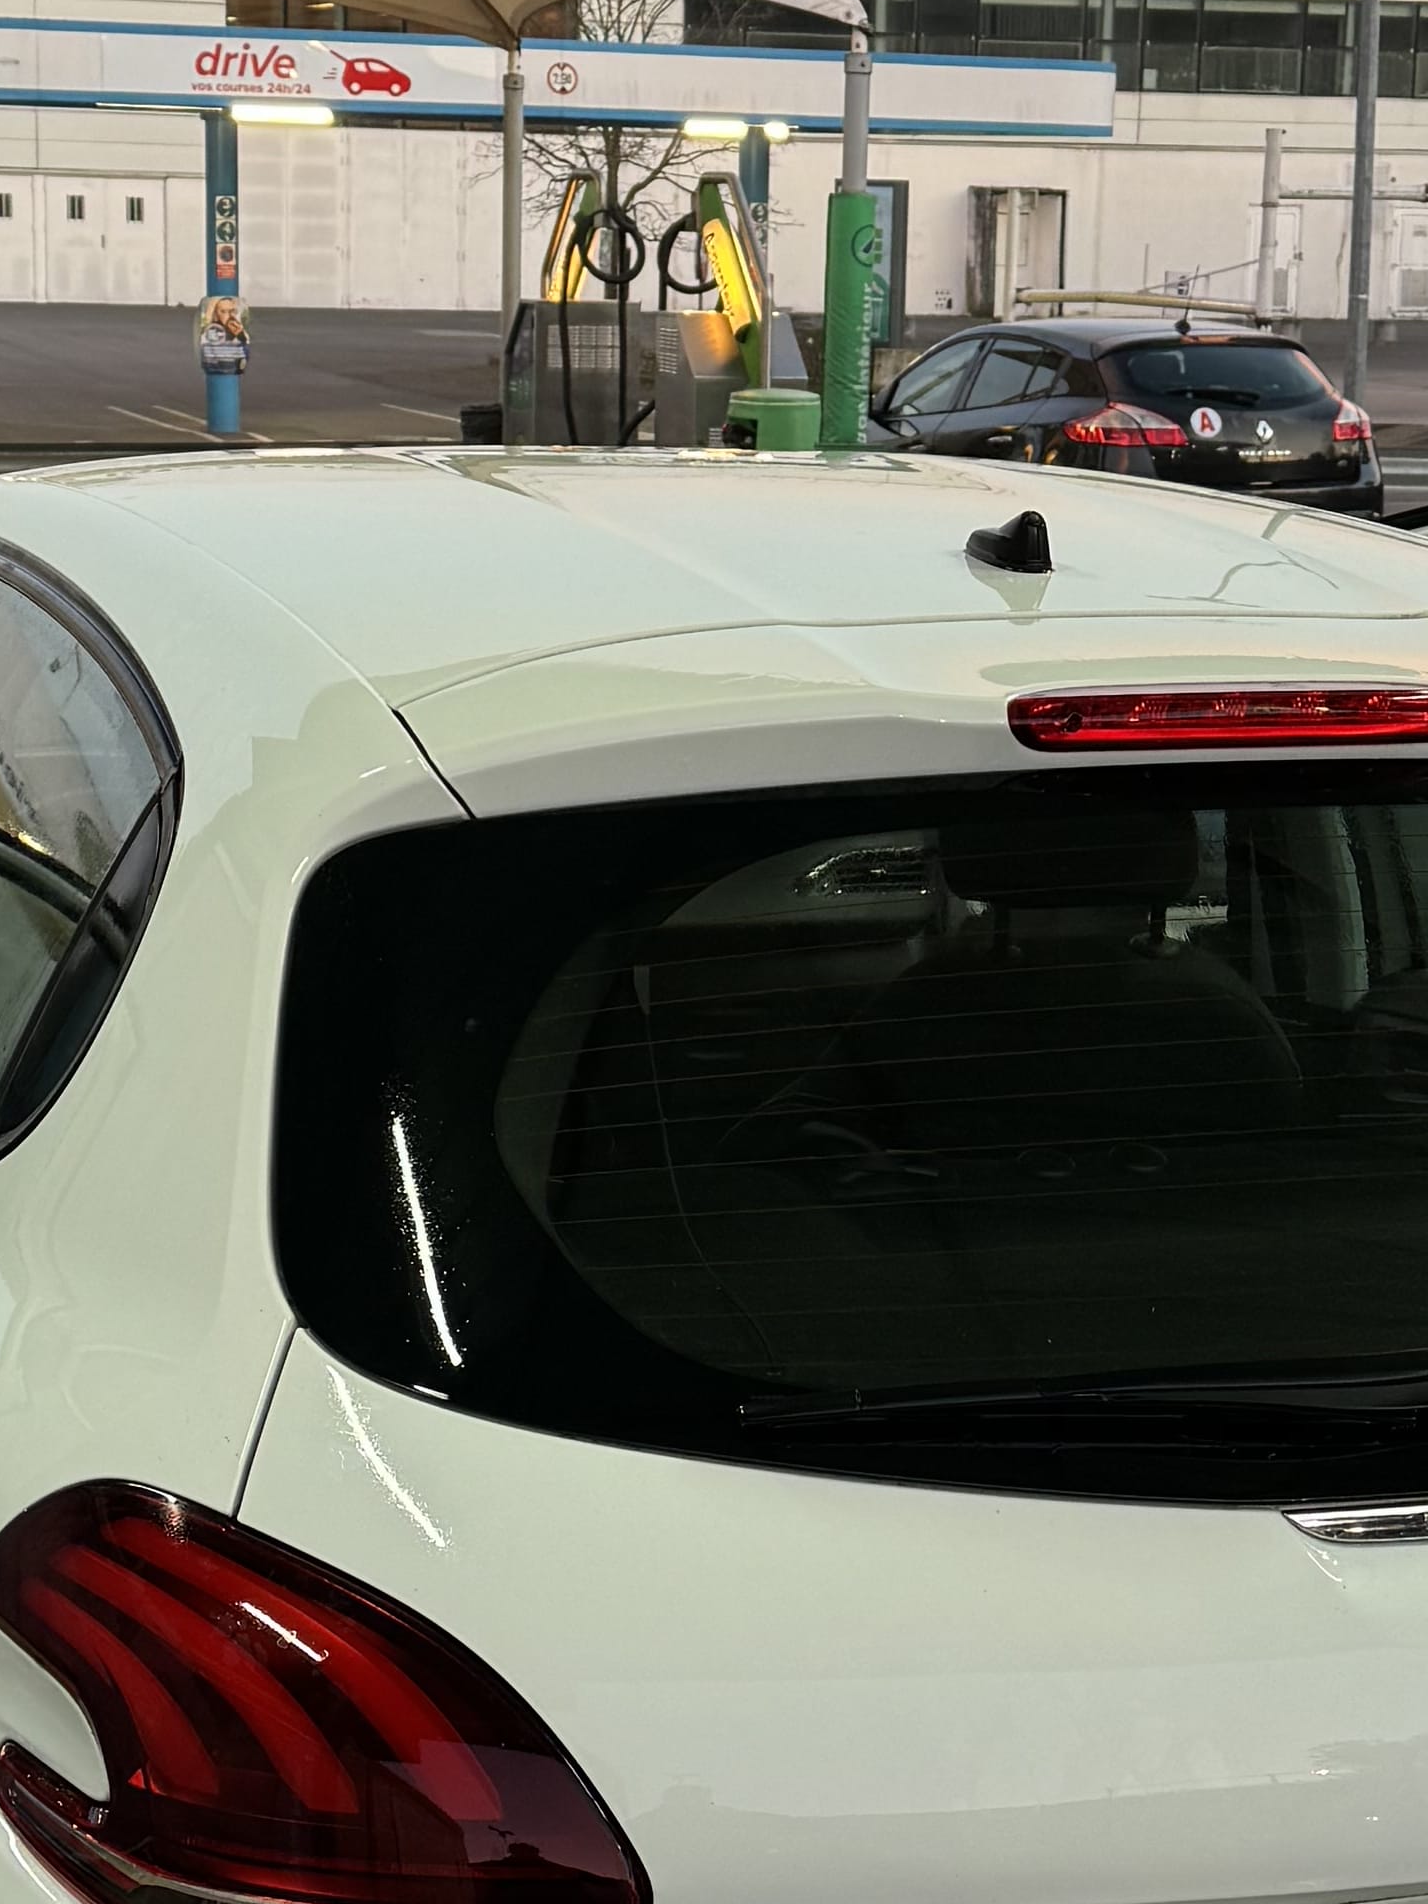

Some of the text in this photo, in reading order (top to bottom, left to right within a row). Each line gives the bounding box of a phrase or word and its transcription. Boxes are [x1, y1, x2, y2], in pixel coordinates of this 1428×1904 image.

[195, 42, 297, 79] drive
[192, 82, 312, 95] vos courses 24h/24
[1200, 410, 1216, 433] A
